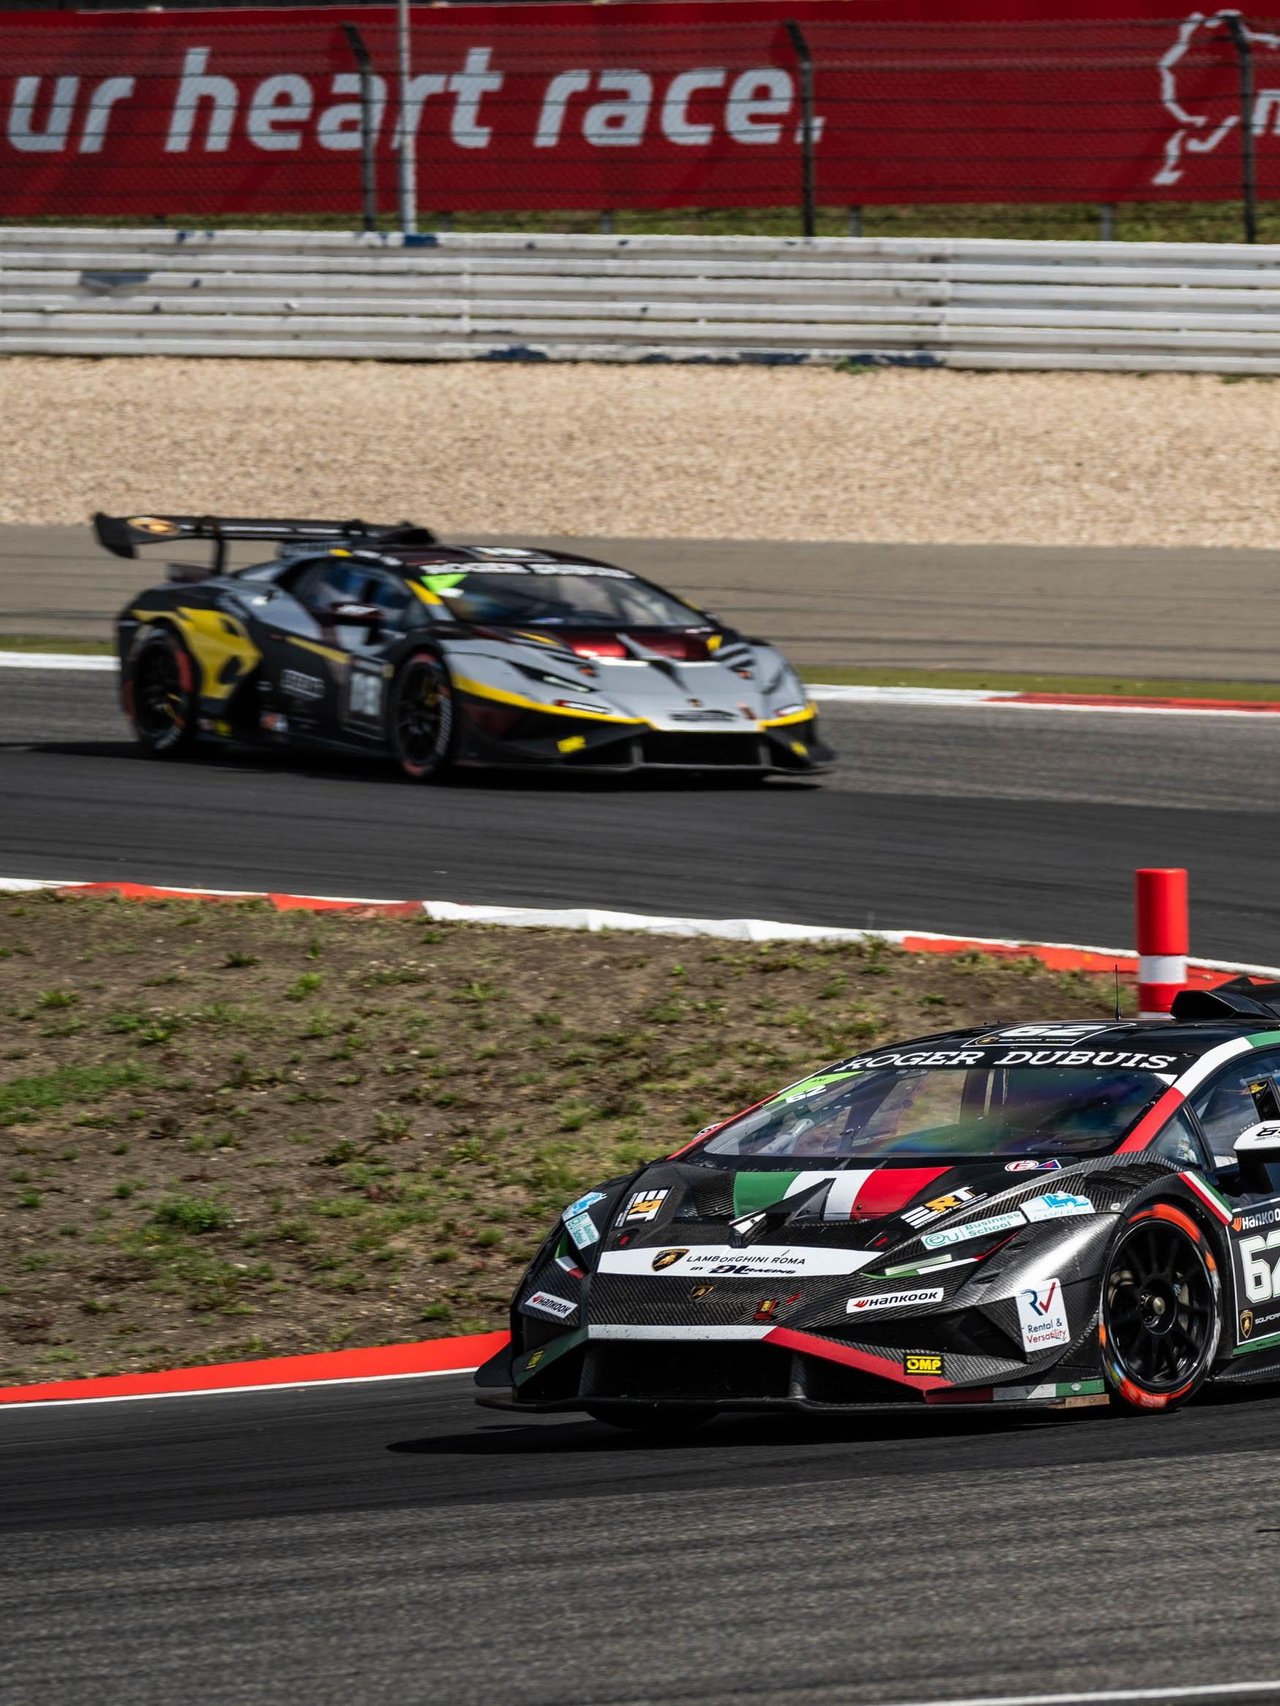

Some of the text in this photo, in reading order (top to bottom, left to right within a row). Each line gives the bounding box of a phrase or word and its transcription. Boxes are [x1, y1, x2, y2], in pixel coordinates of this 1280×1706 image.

[165, 47, 503, 152] heart
[999, 1025, 1107, 1037] 62
[833, 1050, 1178, 1072] ROGER DUBUIS
[965, 1212, 1020, 1230] Business
[968, 1221, 1012, 1237] School
[686, 1255, 806, 1265] LAMBORGHINI ROMA
[1027, 1317, 1063, 1334] Rental &
[906, 1358, 942, 1371] OMP
